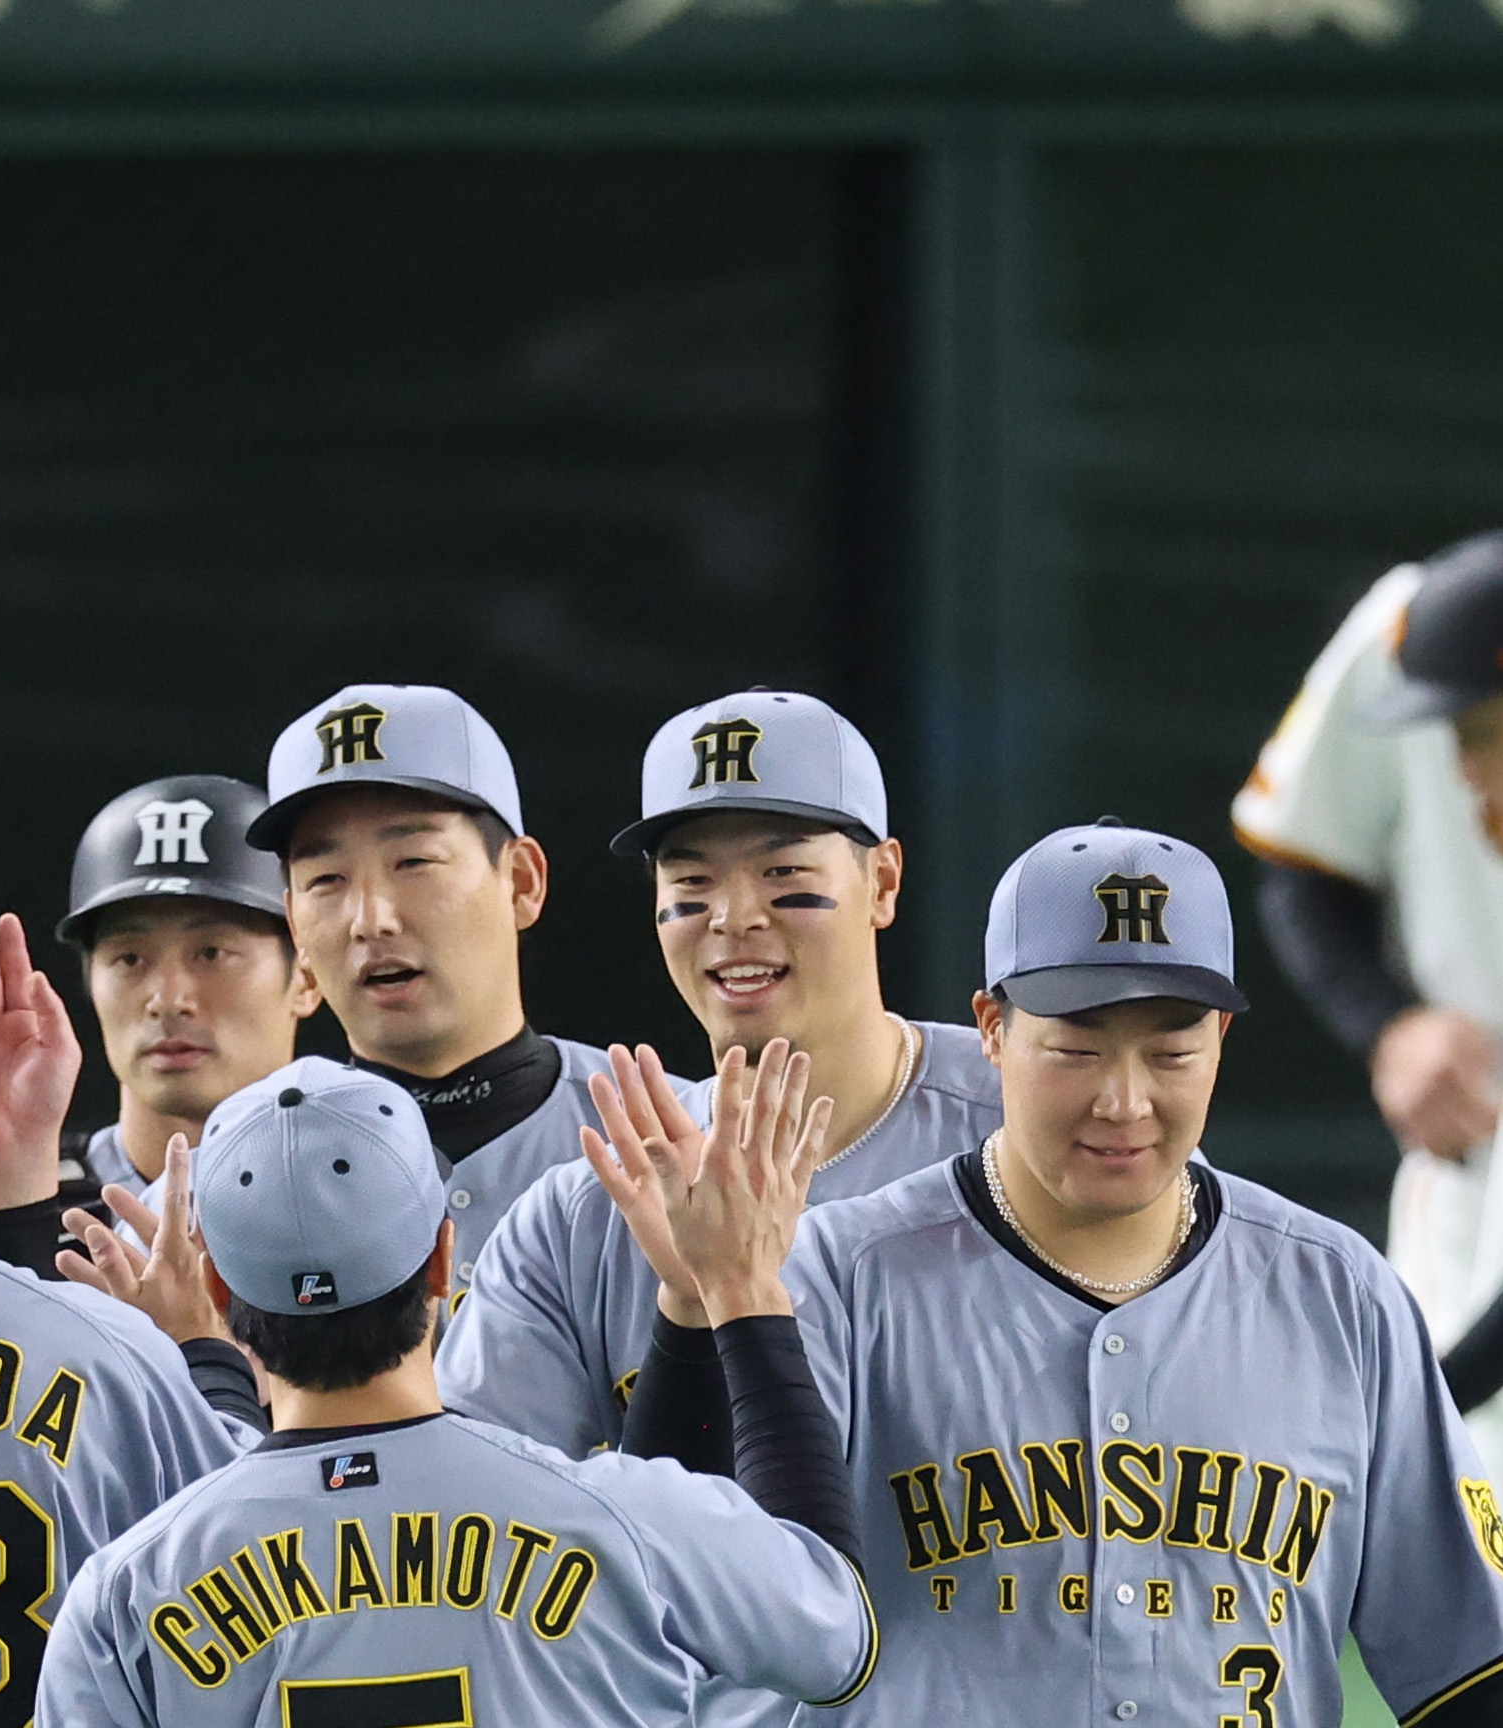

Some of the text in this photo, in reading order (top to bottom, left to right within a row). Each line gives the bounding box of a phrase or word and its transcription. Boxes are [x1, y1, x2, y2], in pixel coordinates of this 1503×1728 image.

[889, 1439, 1335, 1587] HANSHIN
[149, 1511, 598, 1689] CHIKAMOTO
[931, 1573, 1287, 1627] TIGERS
